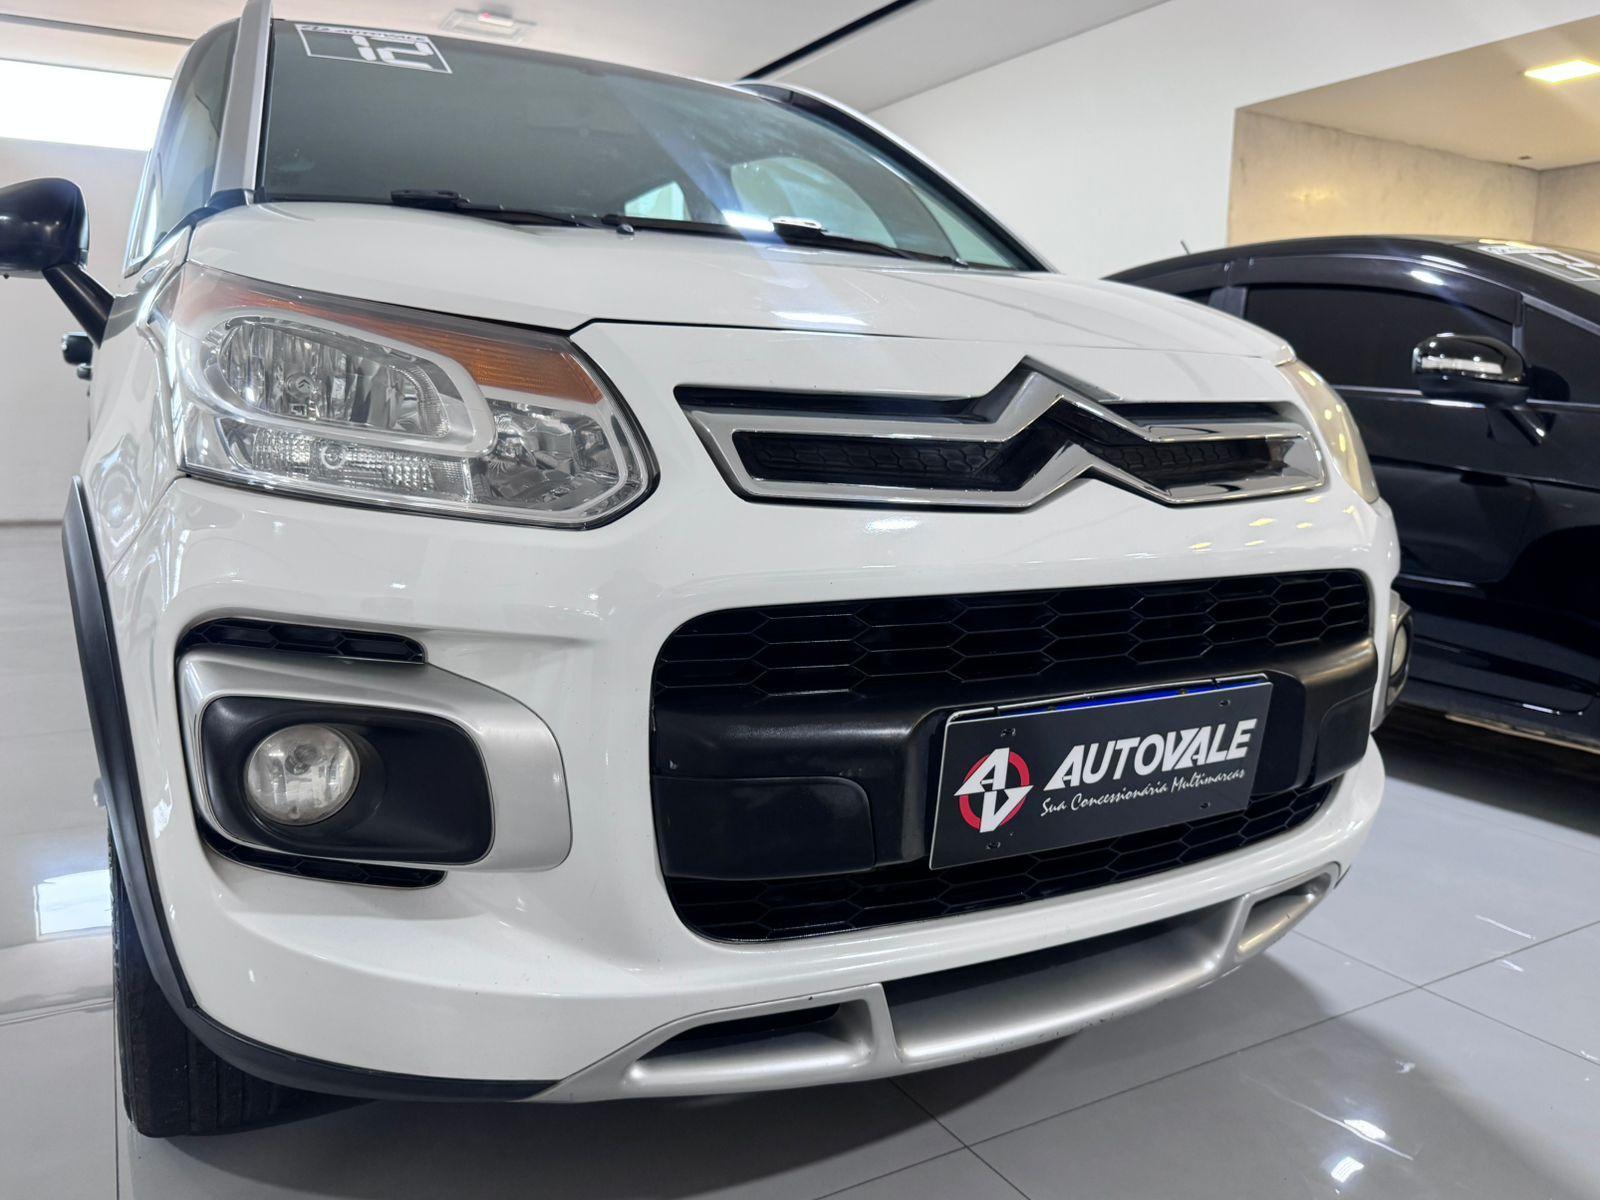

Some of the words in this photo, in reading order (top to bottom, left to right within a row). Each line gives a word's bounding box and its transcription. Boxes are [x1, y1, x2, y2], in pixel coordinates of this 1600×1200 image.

[351, 35, 434, 70] 12
[1043, 718, 1258, 791] AUTOVALE
[1040, 797, 1067, 817] Sua
[1071, 781, 1168, 811] Concessionária
[1171, 768, 1246, 793] Multimarcas
